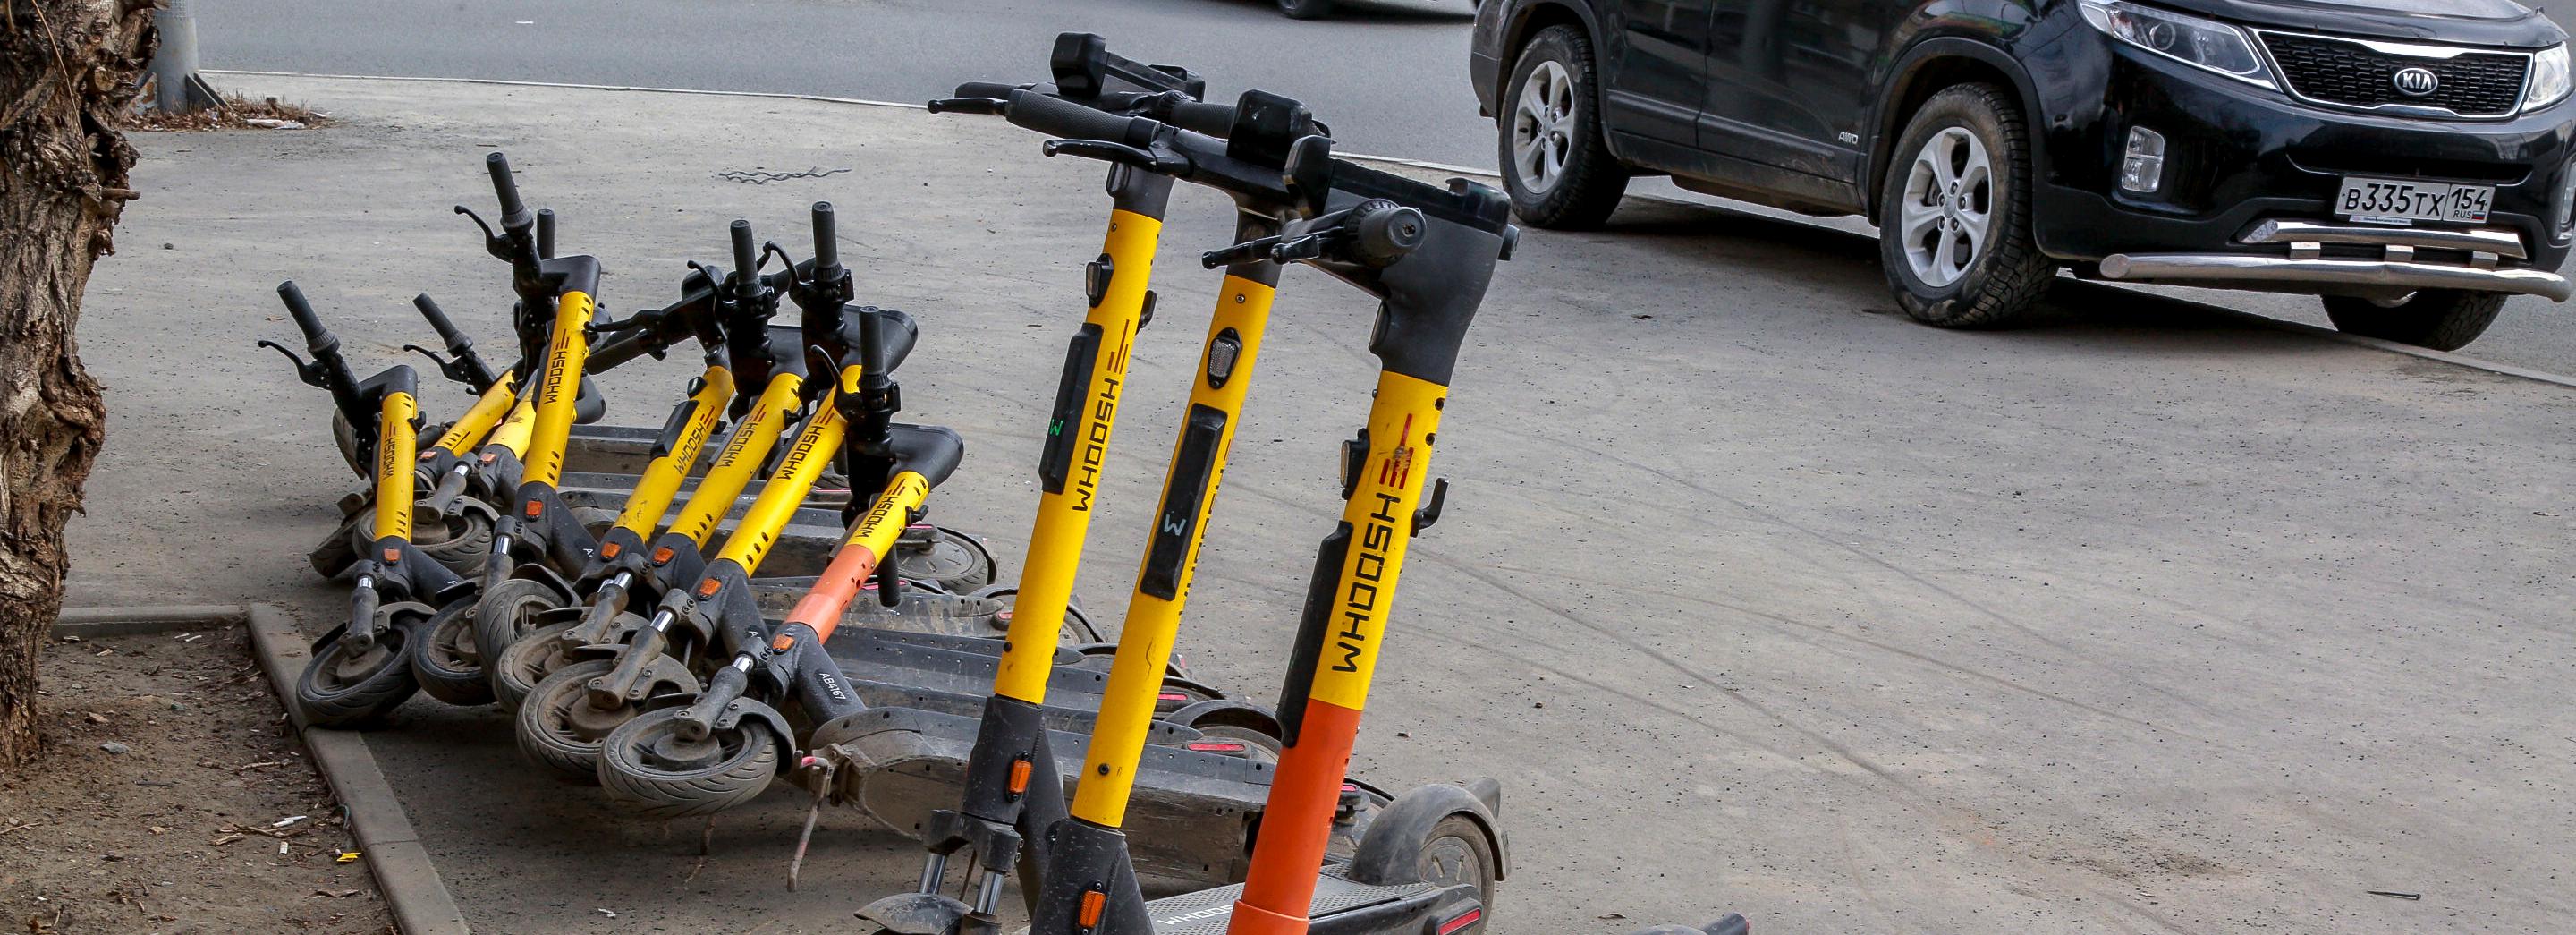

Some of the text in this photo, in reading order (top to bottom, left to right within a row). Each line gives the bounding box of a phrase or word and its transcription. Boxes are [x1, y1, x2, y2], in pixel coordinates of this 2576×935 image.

[2402, 72, 2432, 89] KIA
[2451, 188, 2487, 211] 154
[2453, 210, 2471, 219] RUS
[544, 350, 567, 405] WHOOSH
[674, 421, 707, 474] WHOOSH
[716, 422, 758, 467] WHOOSH
[777, 425, 825, 480] WHOOSH
[1072, 378, 1119, 512] WHOOSH
[855, 496, 898, 538] WHOOSH
[1332, 492, 1401, 673] WHOOSH
[819, 673, 846, 700] AB4167
